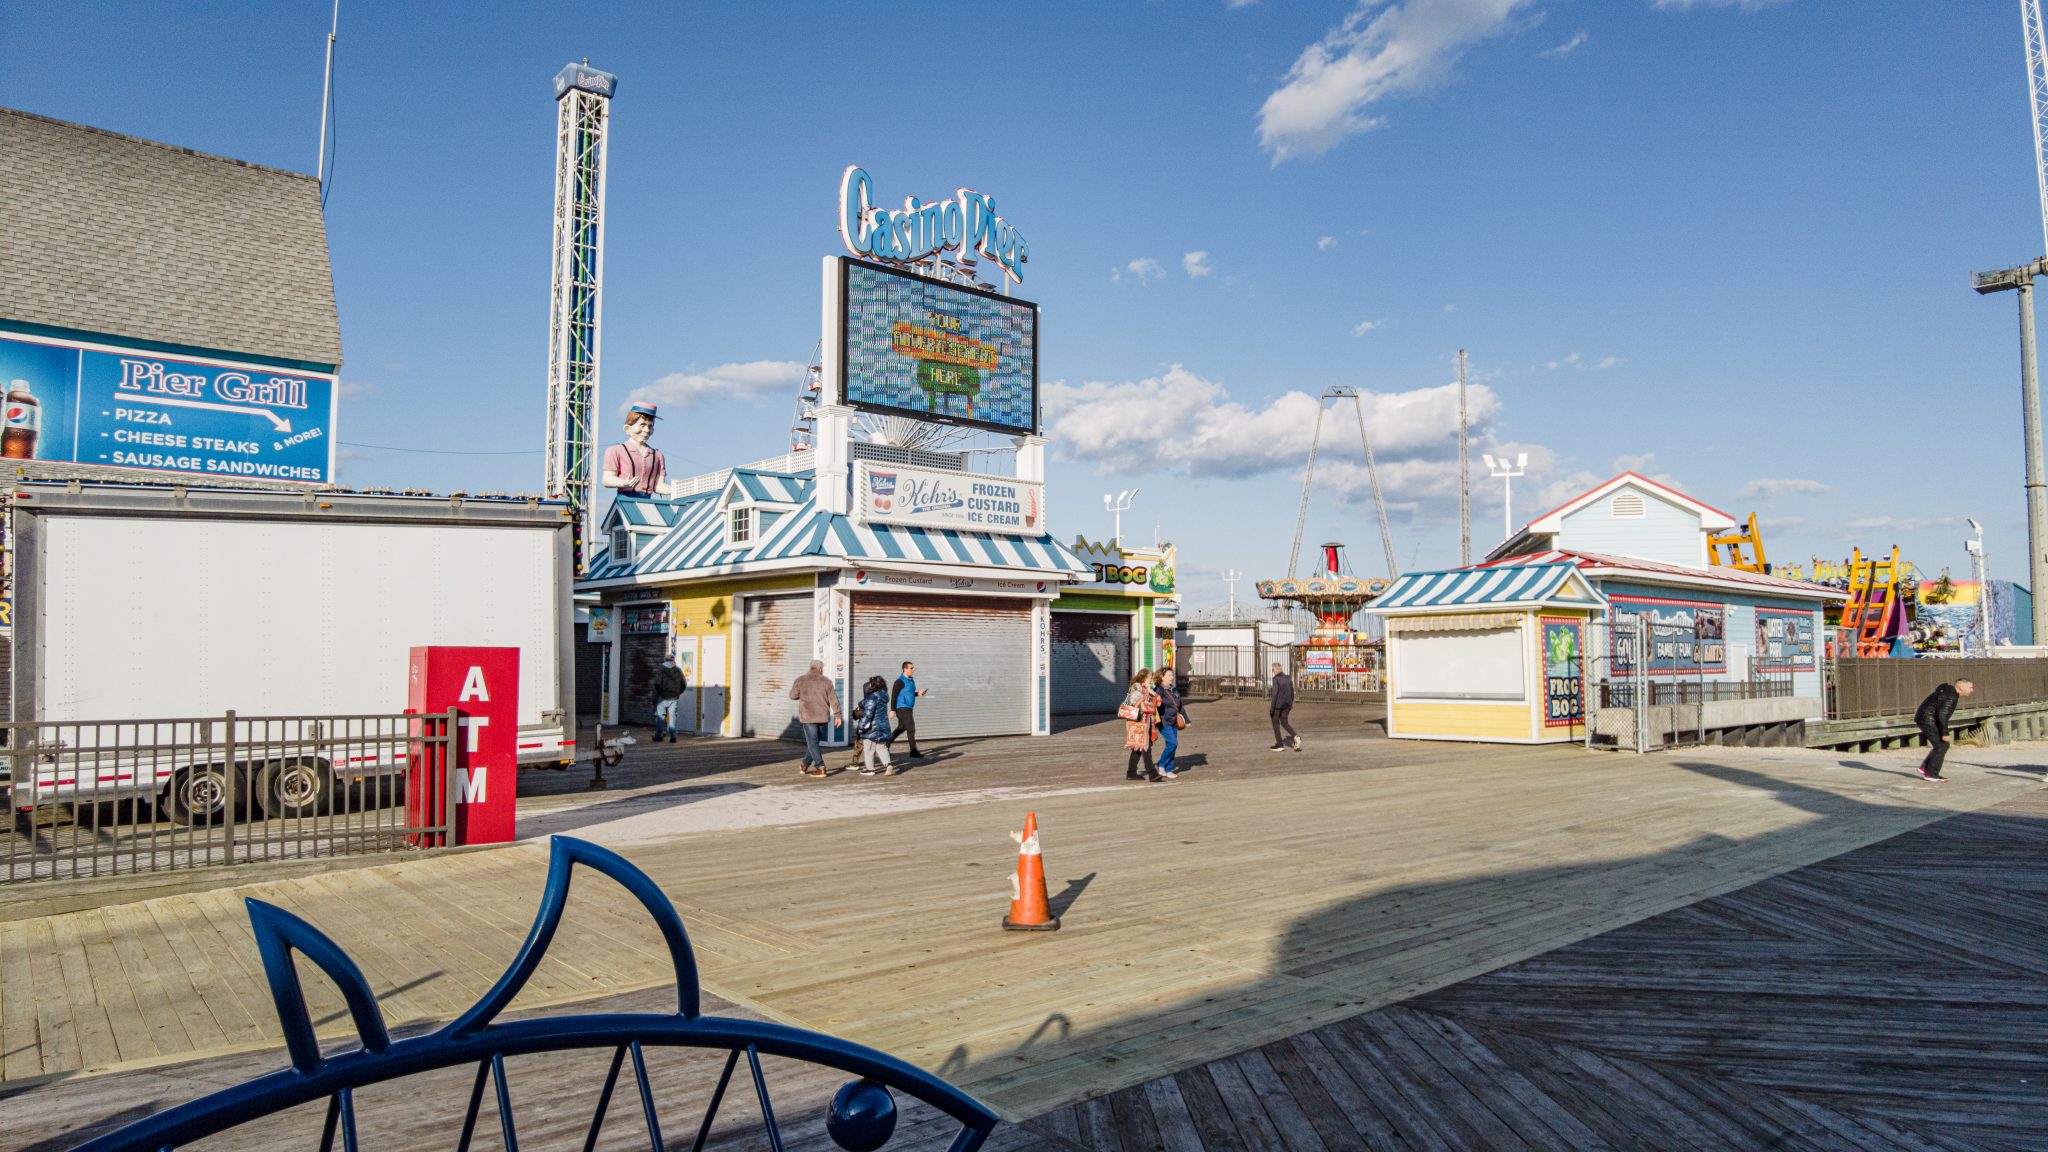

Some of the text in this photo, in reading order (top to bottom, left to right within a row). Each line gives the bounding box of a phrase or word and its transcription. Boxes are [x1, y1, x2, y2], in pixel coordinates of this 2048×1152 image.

[839, 165, 1029, 284] Casino Pier
[119, 358, 308, 409] Pier Grill
[931, 367, 962, 385] HERE
[115, 408, 172, 426] PIZZA
[113, 429, 260, 454] CHEESE STEAKS
[273, 427, 323, 451] & MORE!
[112, 451, 321, 479] SAUSAGE SANDWICHES
[898, 478, 958, 508] Kohr's
[972, 482, 1016, 499] FROZEN
[967, 498, 1020, 514] CUSTARD
[967, 512, 1020, 526] ICE CREAM
[885, 575, 933, 585] Frozen Custard
[1104, 564, 1148, 585] BOG
[997, 581, 1026, 589] Ice Cream
[837, 610, 845, 651] KOHRS
[1679, 642, 1691, 660] FUN
[1549, 677, 1579, 697] FROG
[1551, 698, 1579, 718] BOG
[456, 666, 490, 804] ATM
